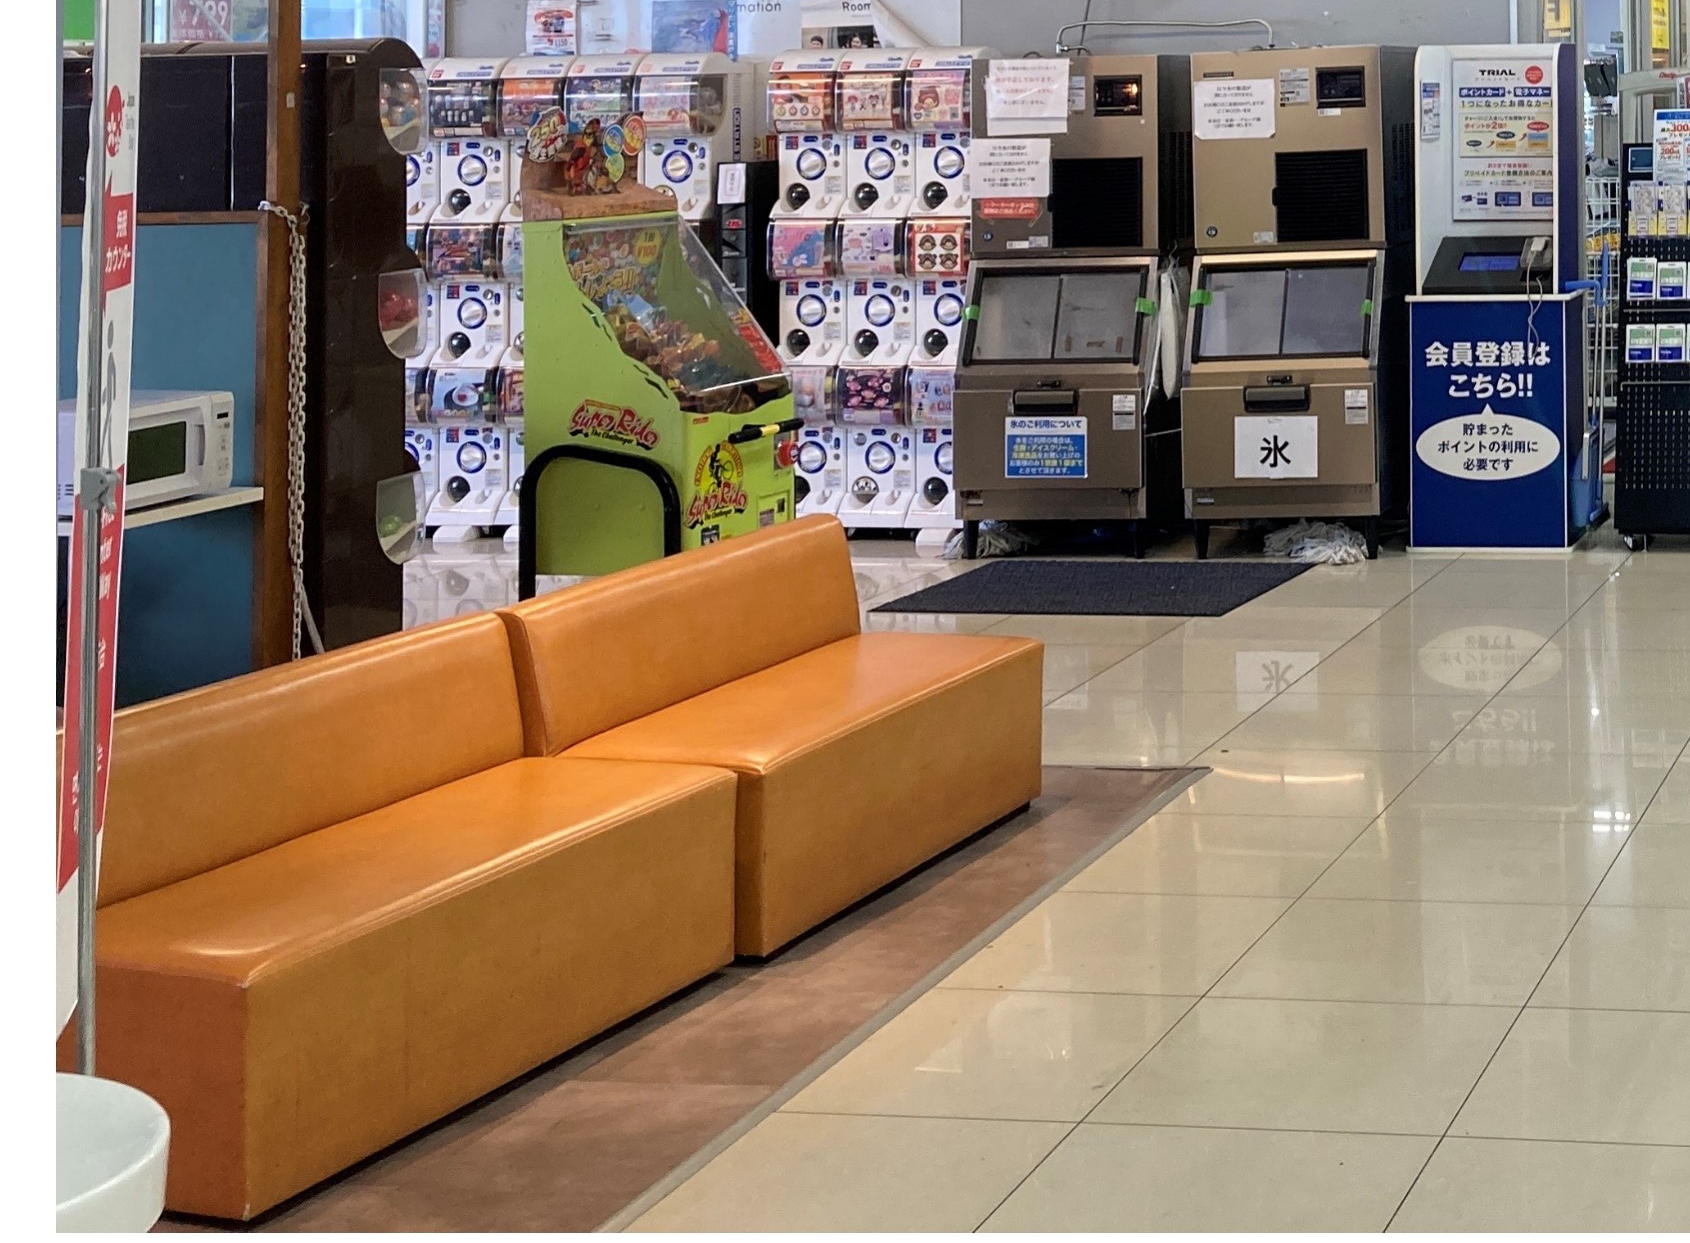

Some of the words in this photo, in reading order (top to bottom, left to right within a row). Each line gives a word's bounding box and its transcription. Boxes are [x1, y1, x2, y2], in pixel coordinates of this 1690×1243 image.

[1460, 88, 1504, 96] ポイントカード
[1425, 341, 1551, 368] 会員登録は
[1448, 372, 1533, 399] こちら!!
[1010, 419, 1082, 429] 氷のご利用について
[1462, 423, 1513, 437] 貯まった
[1259, 434, 1292, 467] 氷
[1438, 440, 1539, 454] ポイントの利用に
[1462, 458, 1513, 472] 必要です
